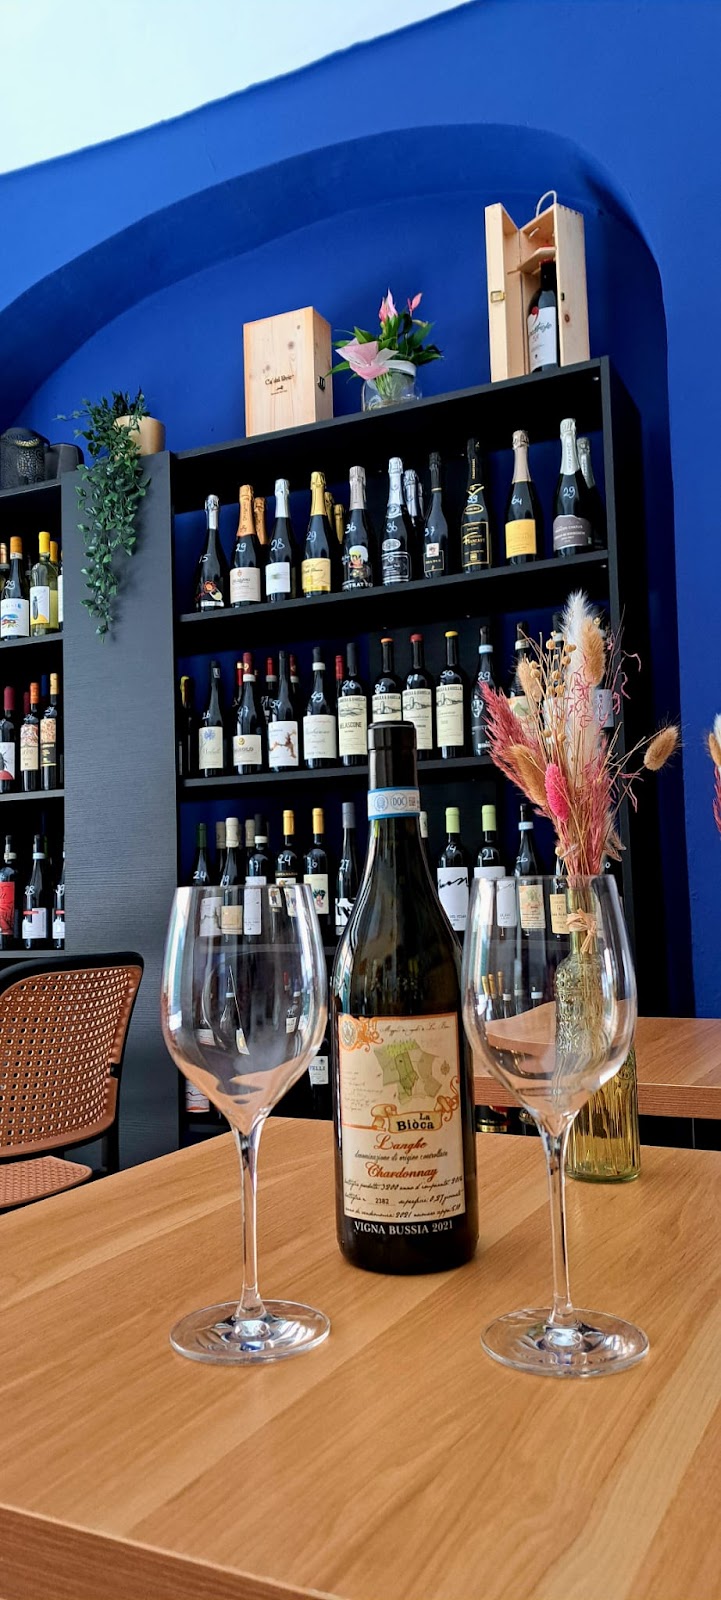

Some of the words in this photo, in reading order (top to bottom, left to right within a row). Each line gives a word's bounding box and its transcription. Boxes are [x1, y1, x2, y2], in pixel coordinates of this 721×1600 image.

[563, 486, 576, 499] 29
[345, 522, 357, 534] 36
[386, 521, 398, 533] 36
[306, 531, 317, 543] 29
[271, 538, 285, 551] 28
[5, 580, 16, 590] 29
[477, 671, 491, 682] 29
[342, 679, 356, 690] 26
[277, 853, 292, 866] 24
[482, 848, 495, 860] 21
[193, 871, 207, 882] 24
[419, 1112, 431, 1121] La
[396, 1118, 434, 1131] Biòca
[374, 1132, 428, 1155] Langhe
[365, 1160, 439, 1182] Chardonnay
[354, 1220, 386, 1235] VIGNA
[389, 1225, 430, 1235] BUSSIA
[432, 1219, 453, 1233] 2021
